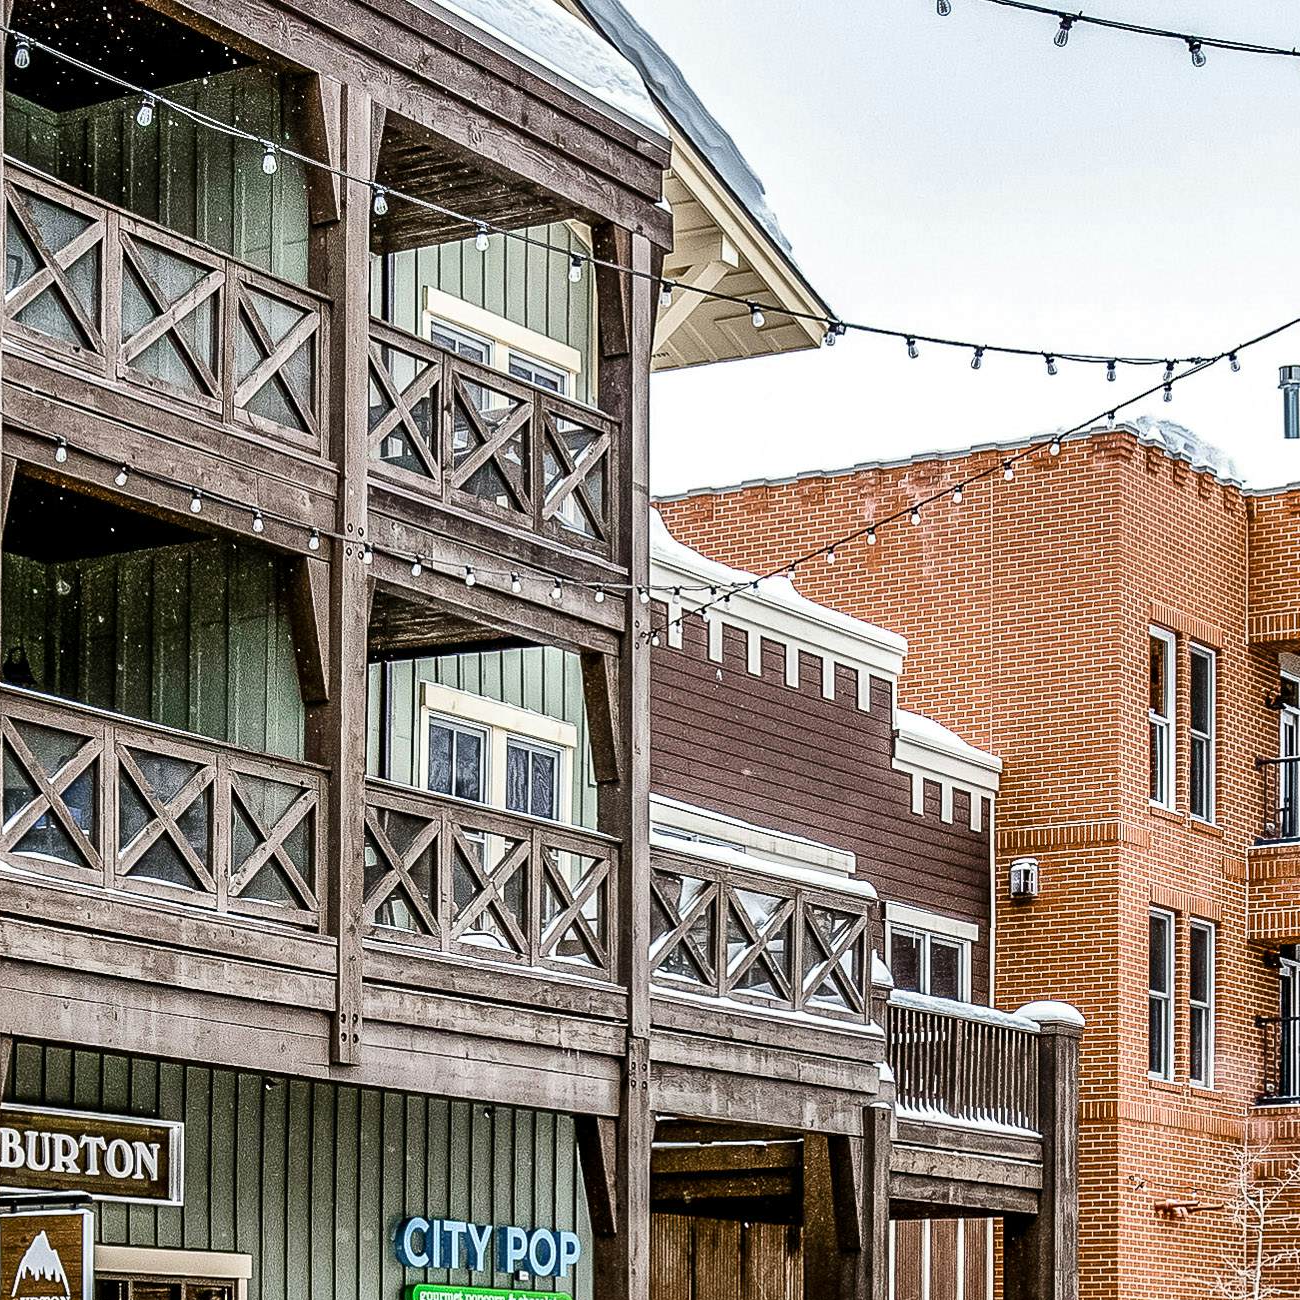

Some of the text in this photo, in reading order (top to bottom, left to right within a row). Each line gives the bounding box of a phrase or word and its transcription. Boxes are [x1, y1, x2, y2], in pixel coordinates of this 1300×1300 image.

[0, 1127, 160, 1182] BURTON
[399, 1217, 581, 1277] CITY POP
